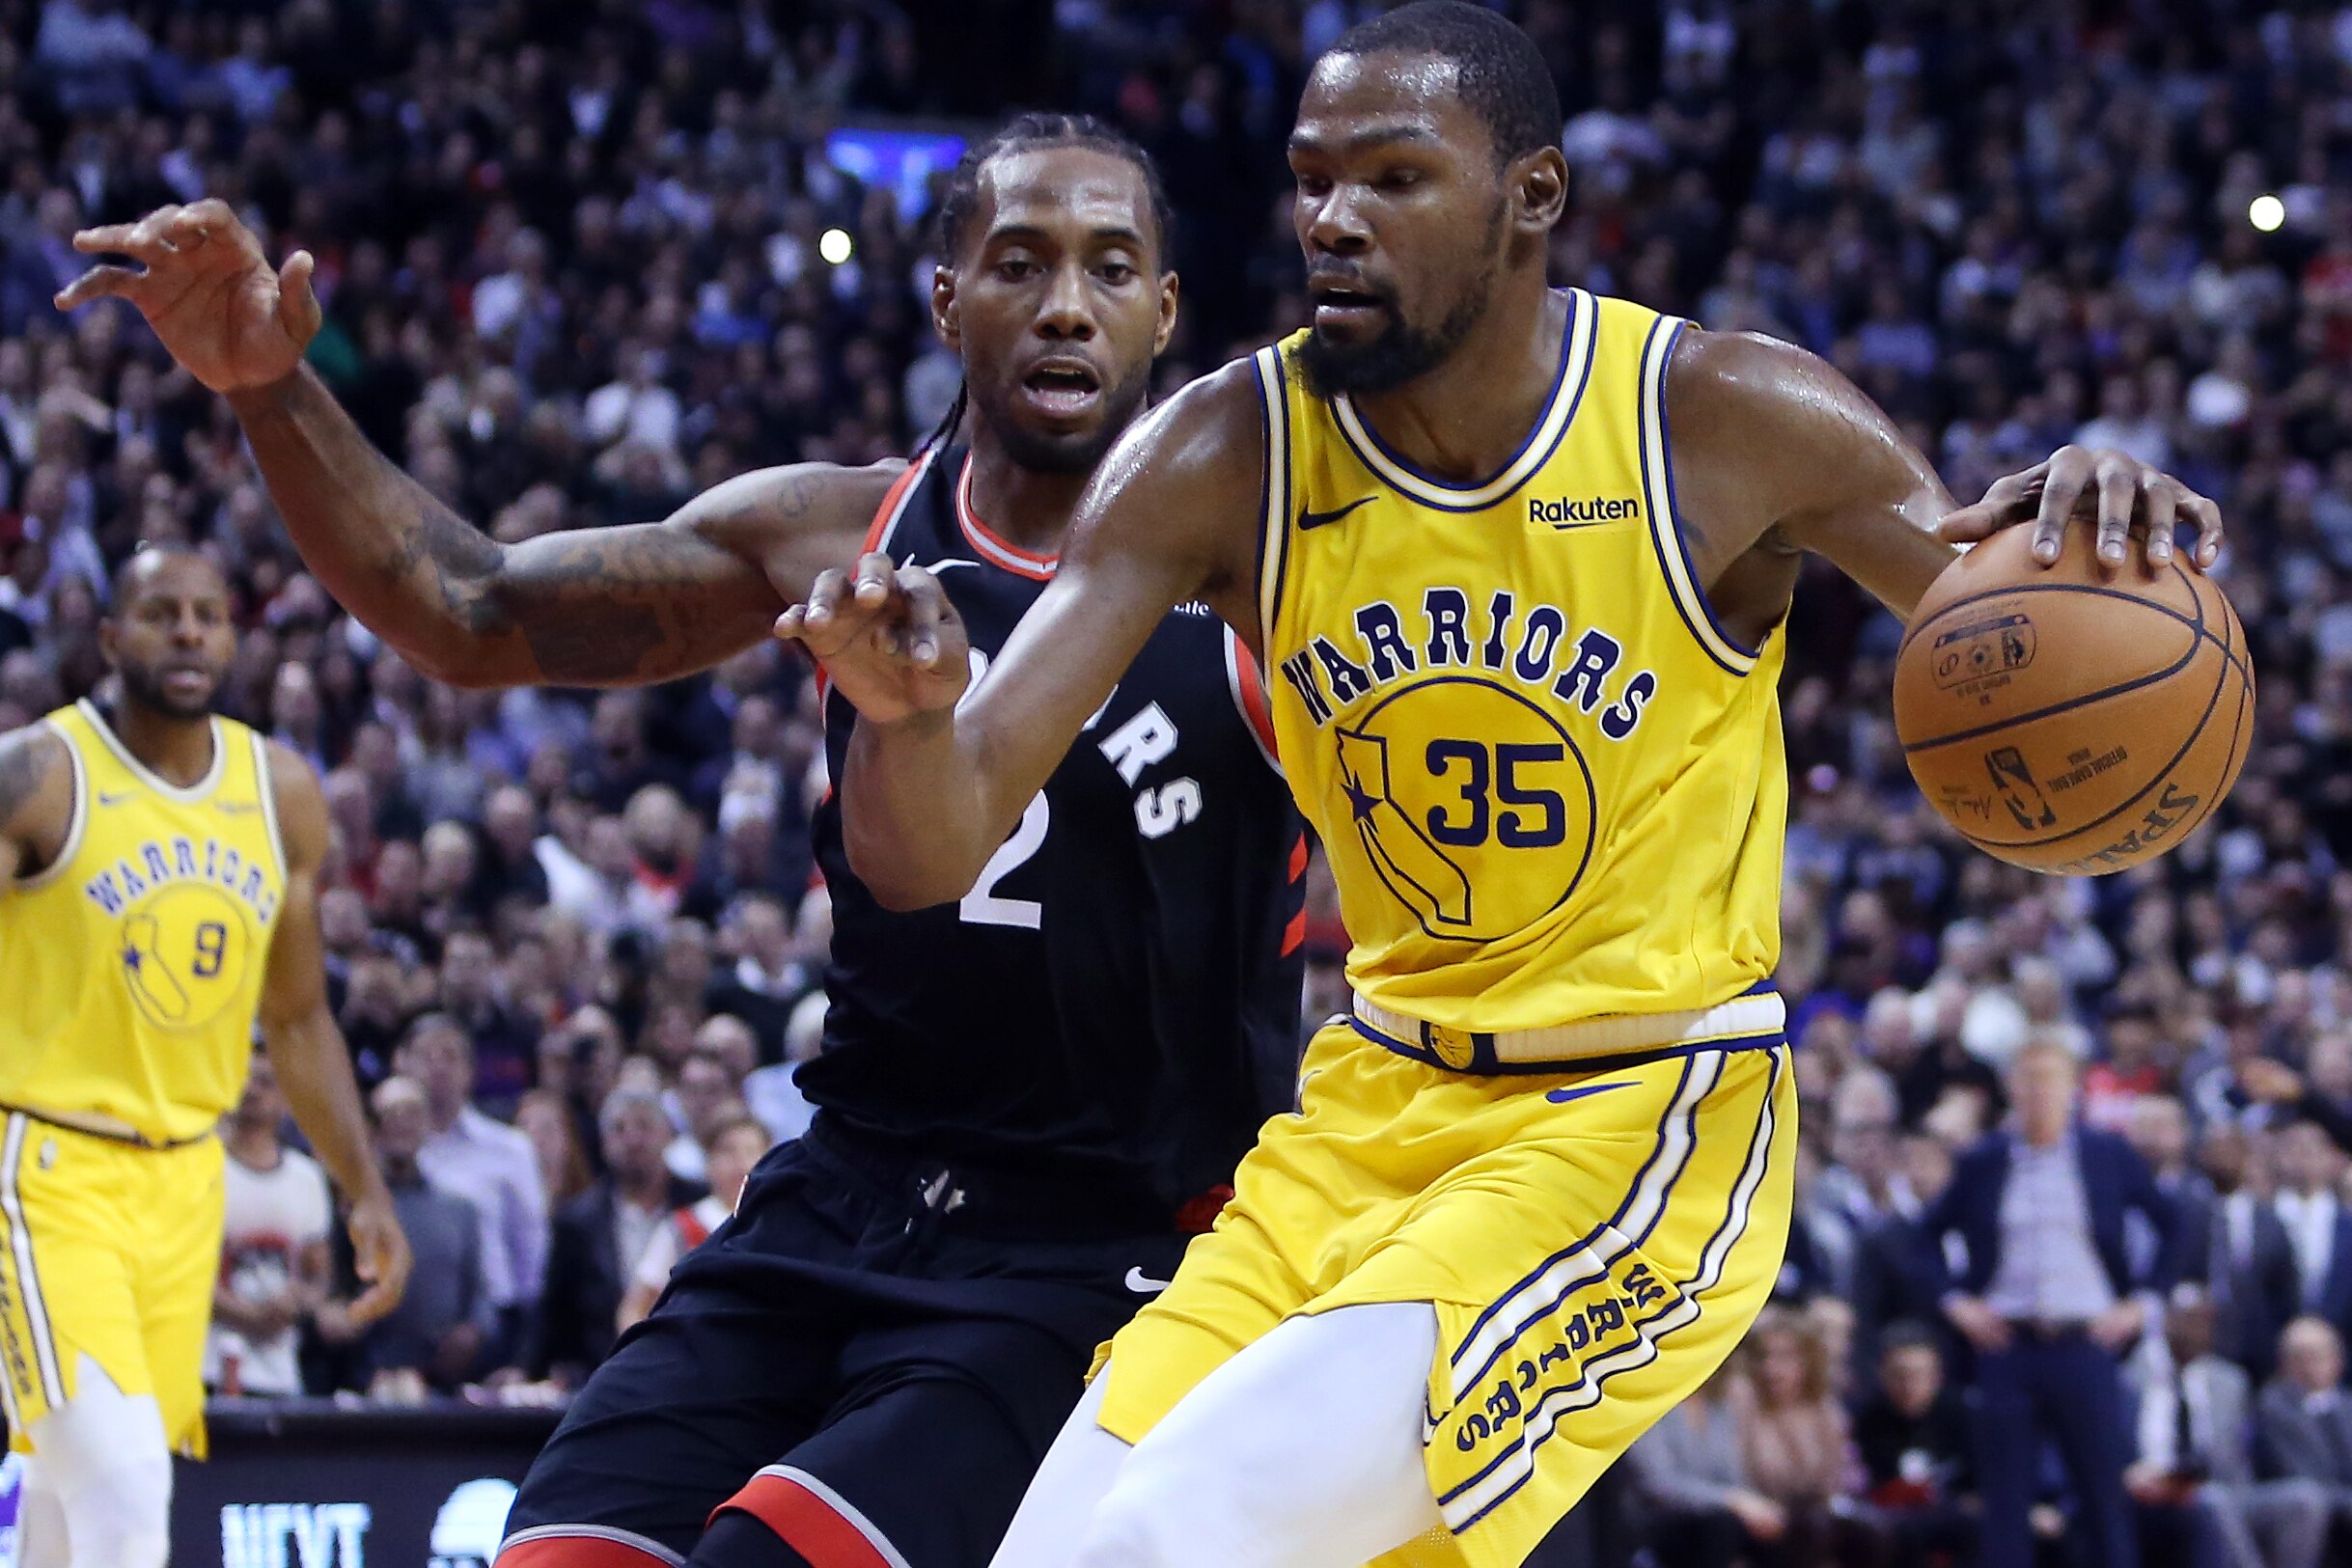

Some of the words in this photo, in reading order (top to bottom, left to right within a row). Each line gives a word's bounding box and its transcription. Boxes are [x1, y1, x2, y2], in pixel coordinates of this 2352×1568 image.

[1529, 497, 1639, 524] Rakuten
[1281, 587, 1657, 741] WARRIORS
[1425, 737, 1565, 848] 35
[2063, 783, 2200, 870] SPAL
[85, 838, 278, 923] WARRIORS
[959, 788, 1050, 929] 2
[193, 922, 227, 977] 9
[1455, 1262, 1666, 1452] WRRIORS
